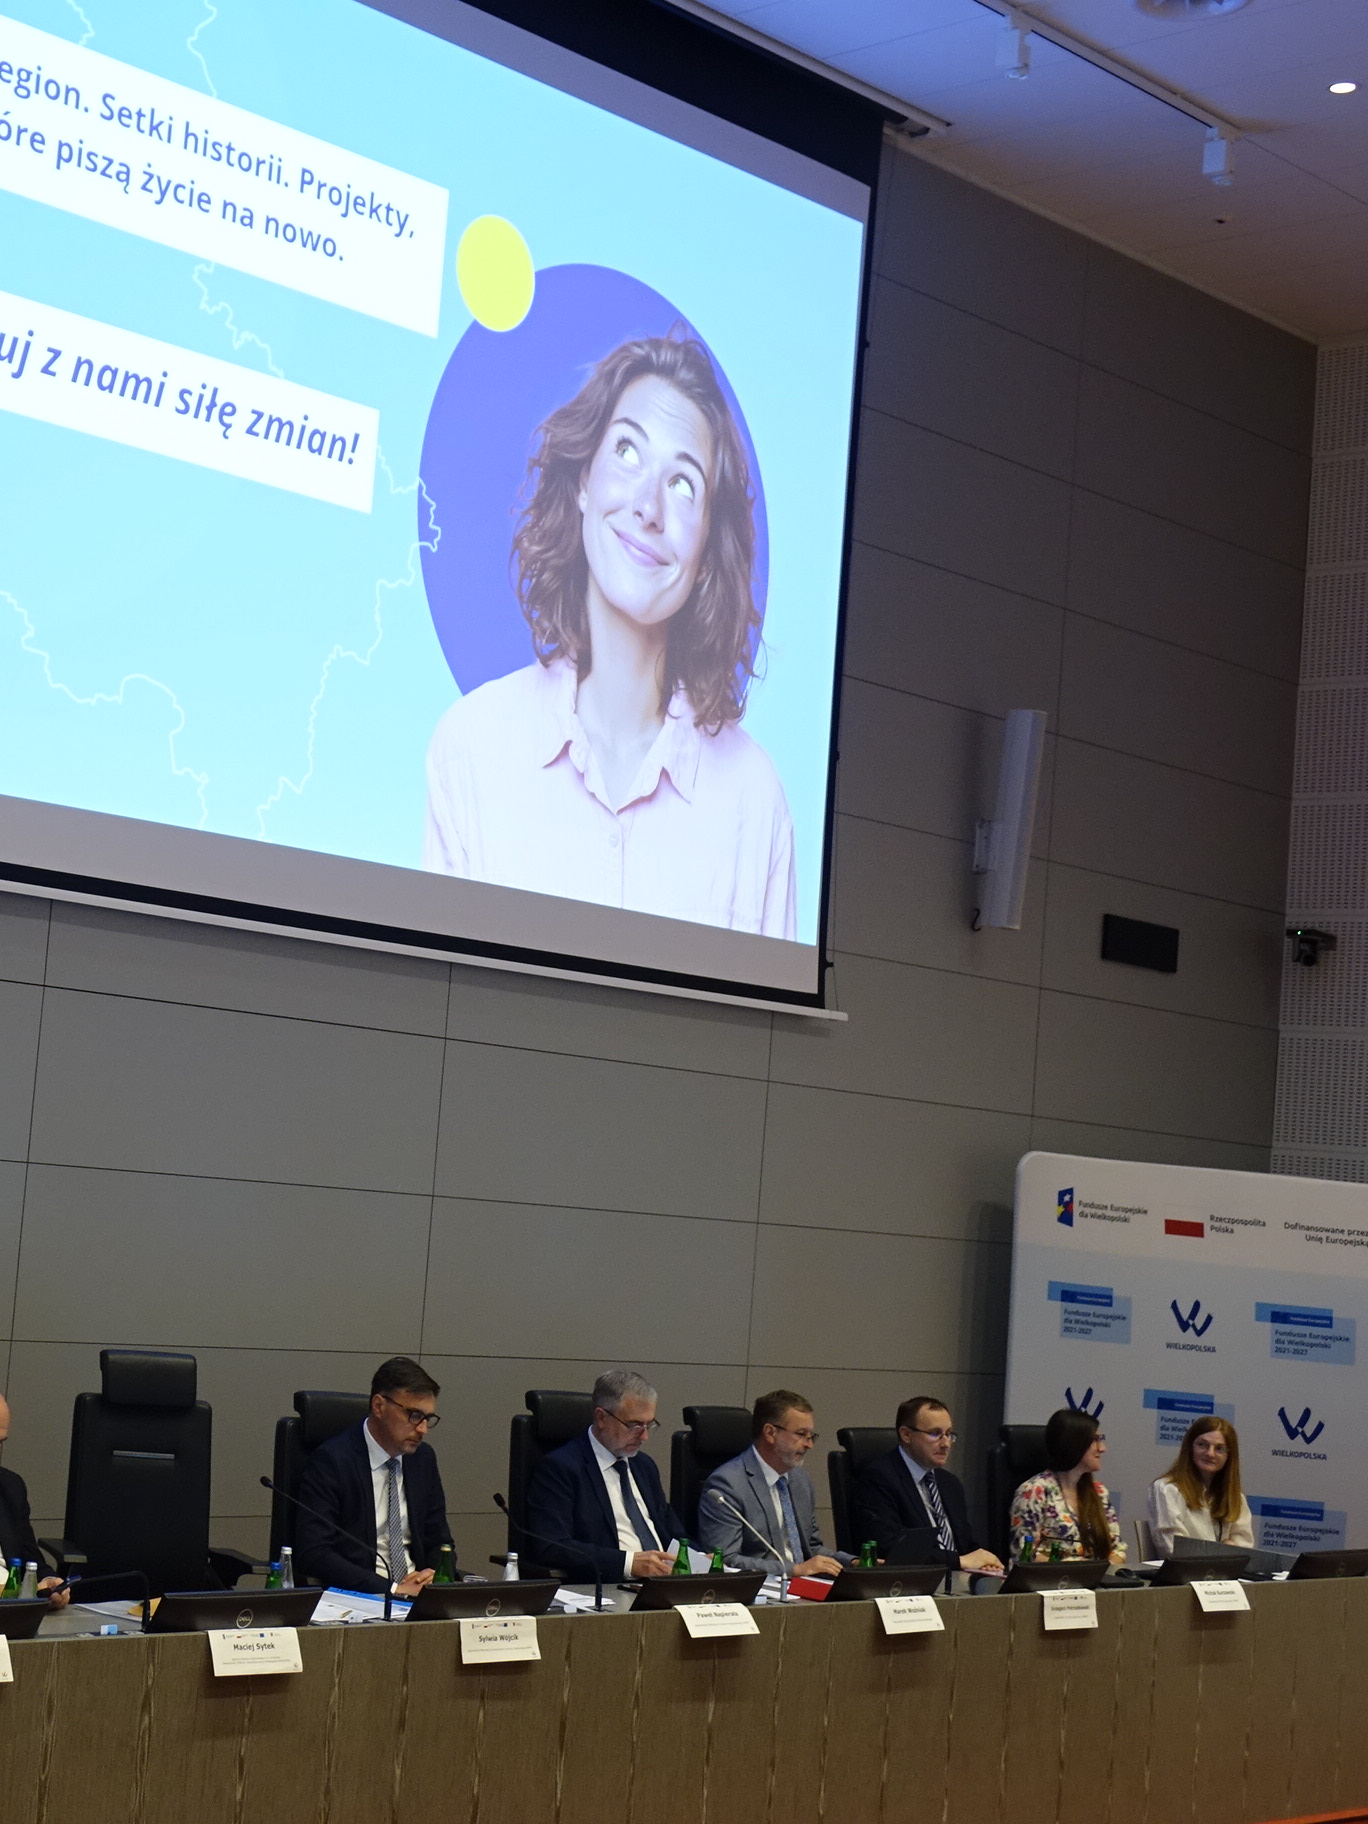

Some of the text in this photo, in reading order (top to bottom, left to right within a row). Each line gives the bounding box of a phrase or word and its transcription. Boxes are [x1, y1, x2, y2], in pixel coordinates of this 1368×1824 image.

[99, 93, 174, 144] Setki
[183, 121, 290, 188] historii.
[300, 167, 415, 240] Projekty,
[55, 139, 132, 194] piszą
[140, 162, 212, 213] życie
[221, 199, 254, 229] na
[264, 214, 344, 262] nowo.
[40, 346, 63, 377] z
[70, 356, 168, 408] nami
[175, 382, 238, 439] siłę
[245, 407, 360, 465] zmian!
[1078, 1200, 1149, 1216] Fundusze Europejskie
[1078, 1210, 1131, 1223] dla Wielkopolski
[1209, 1214, 1267, 1228] Rzeczpospolita
[1209, 1224, 1235, 1234] Polska
[1283, 1221, 1345, 1235] Dofinansowane
[1304, 1233, 1324, 1245] Unię
[1274, 1329, 1308, 1339] Fundusze
[1165, 1342, 1217, 1353] WIELKOPOLSKA
[1274, 1346, 1309, 1356] 2021-2027
[1271, 1449, 1328, 1461] WIELKOPOLSKA
[233, 1642, 275, 1652] Maciej Sytek
